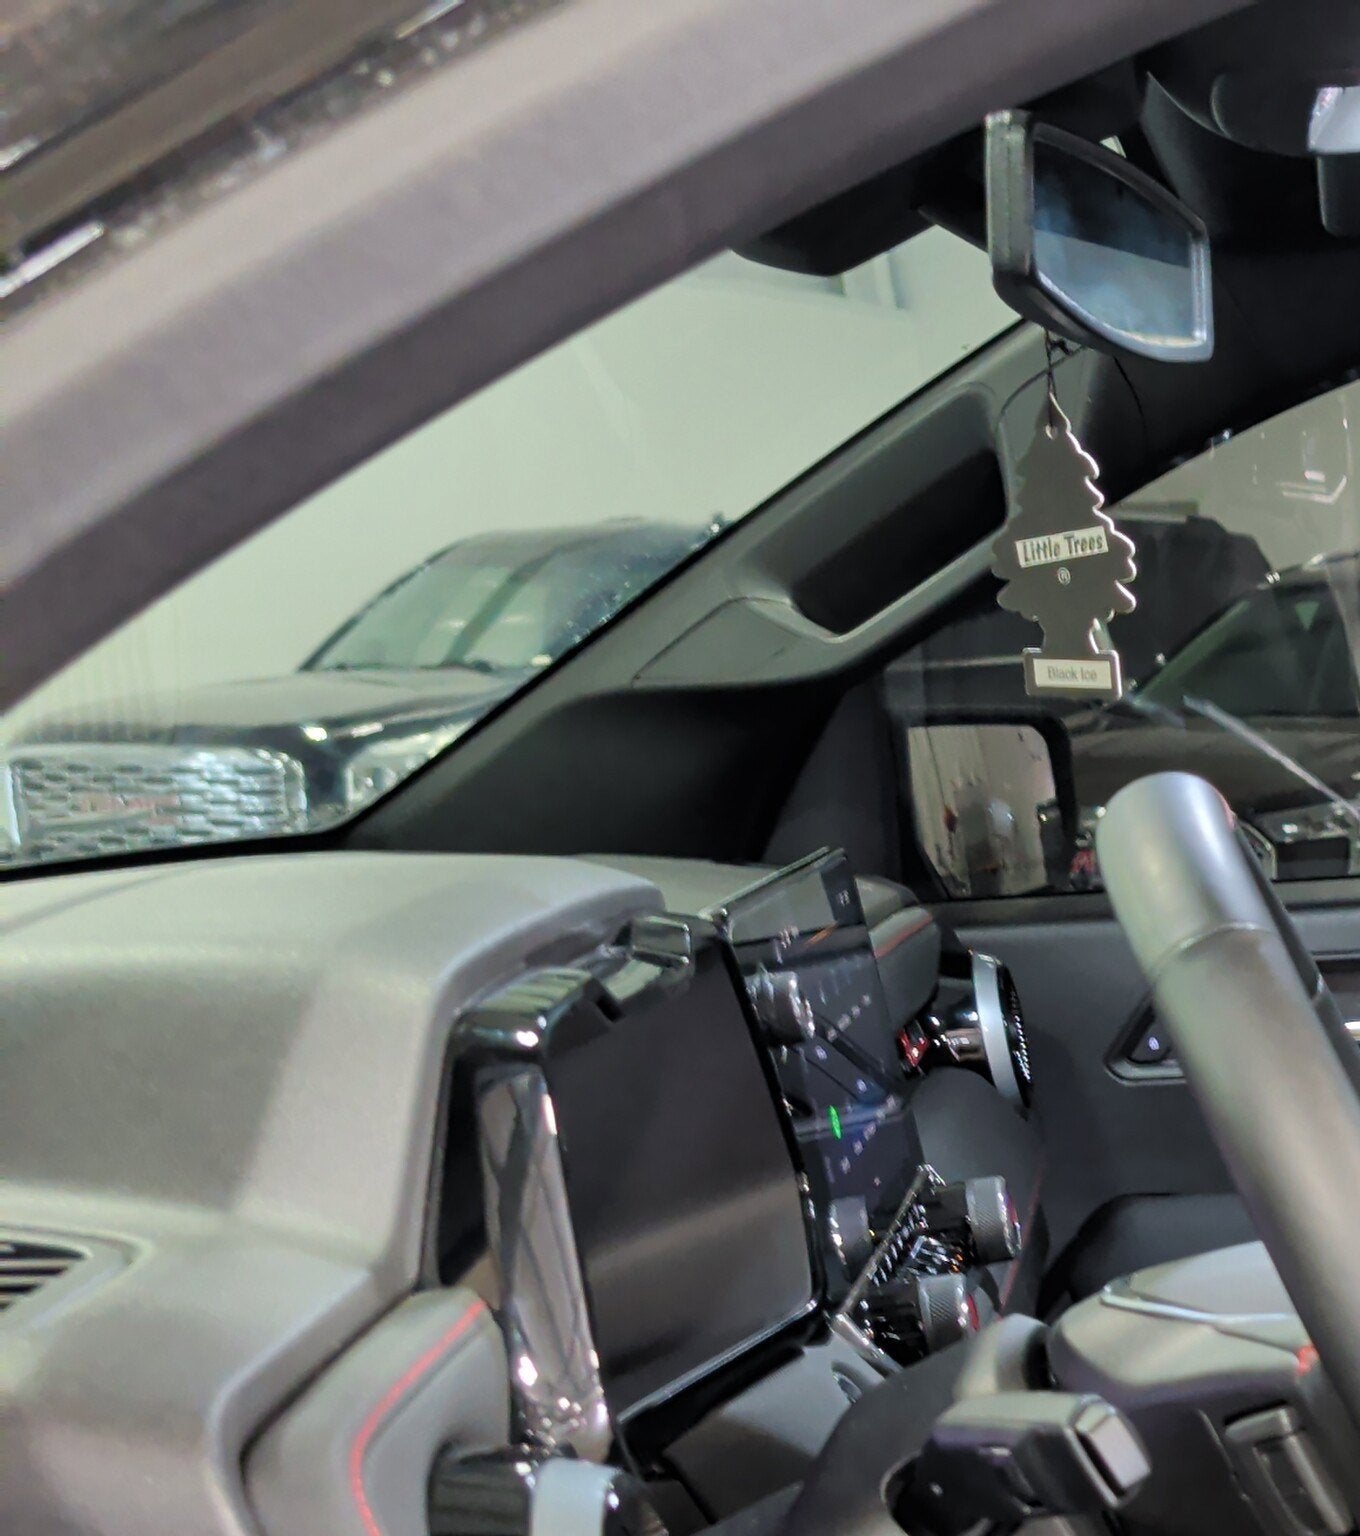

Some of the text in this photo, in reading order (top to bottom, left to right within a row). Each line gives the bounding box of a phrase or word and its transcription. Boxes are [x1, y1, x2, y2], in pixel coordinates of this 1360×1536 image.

[1022, 532, 1104, 563] Little Trees
[1046, 665, 1098, 681] Black Ice
